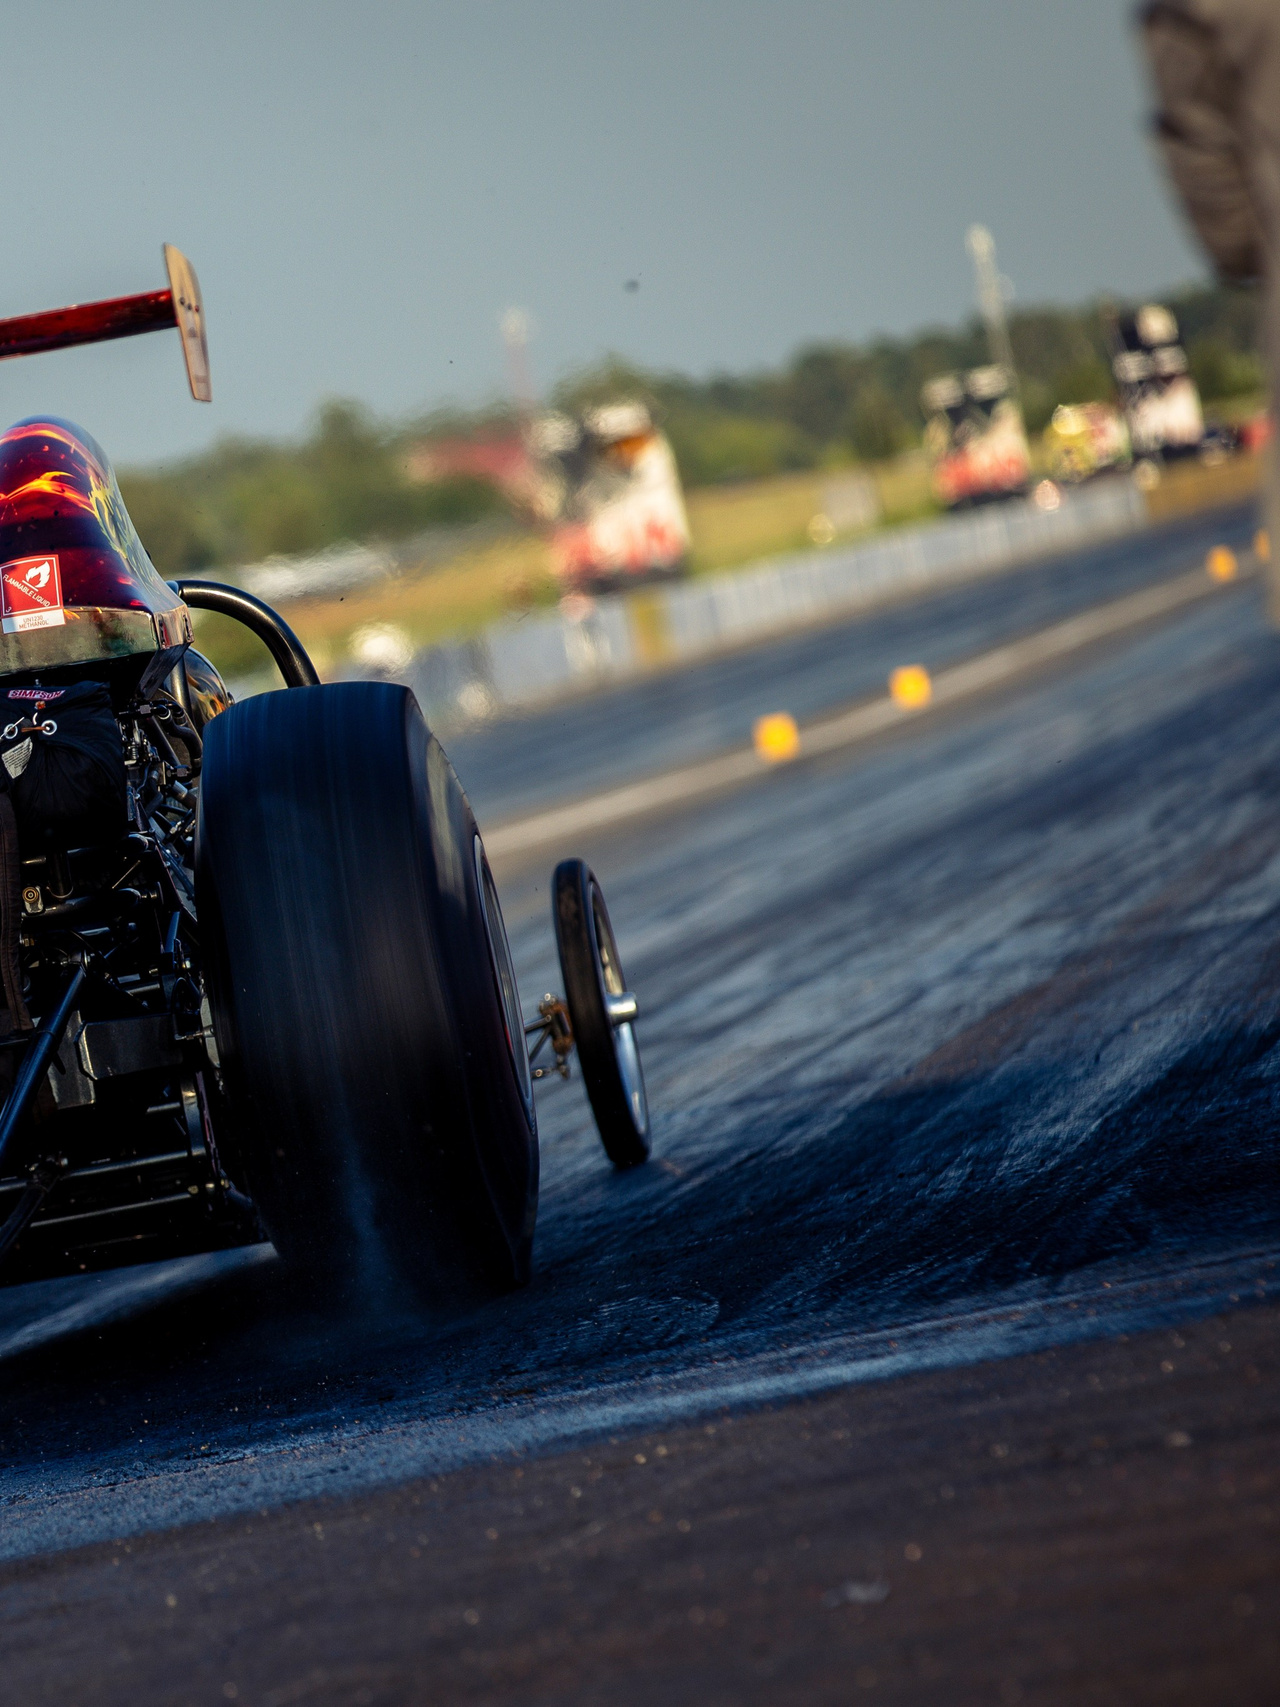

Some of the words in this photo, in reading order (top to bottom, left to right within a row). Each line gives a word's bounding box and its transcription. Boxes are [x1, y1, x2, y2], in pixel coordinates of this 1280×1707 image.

[3, 574, 34, 597] FLAMMABLE
[32, 593, 50, 607] LIQUID
[23, 615, 43, 623] UN1230
[19, 620, 49, 629] METHANOL
[10, 689, 63, 700] SIMPSON
